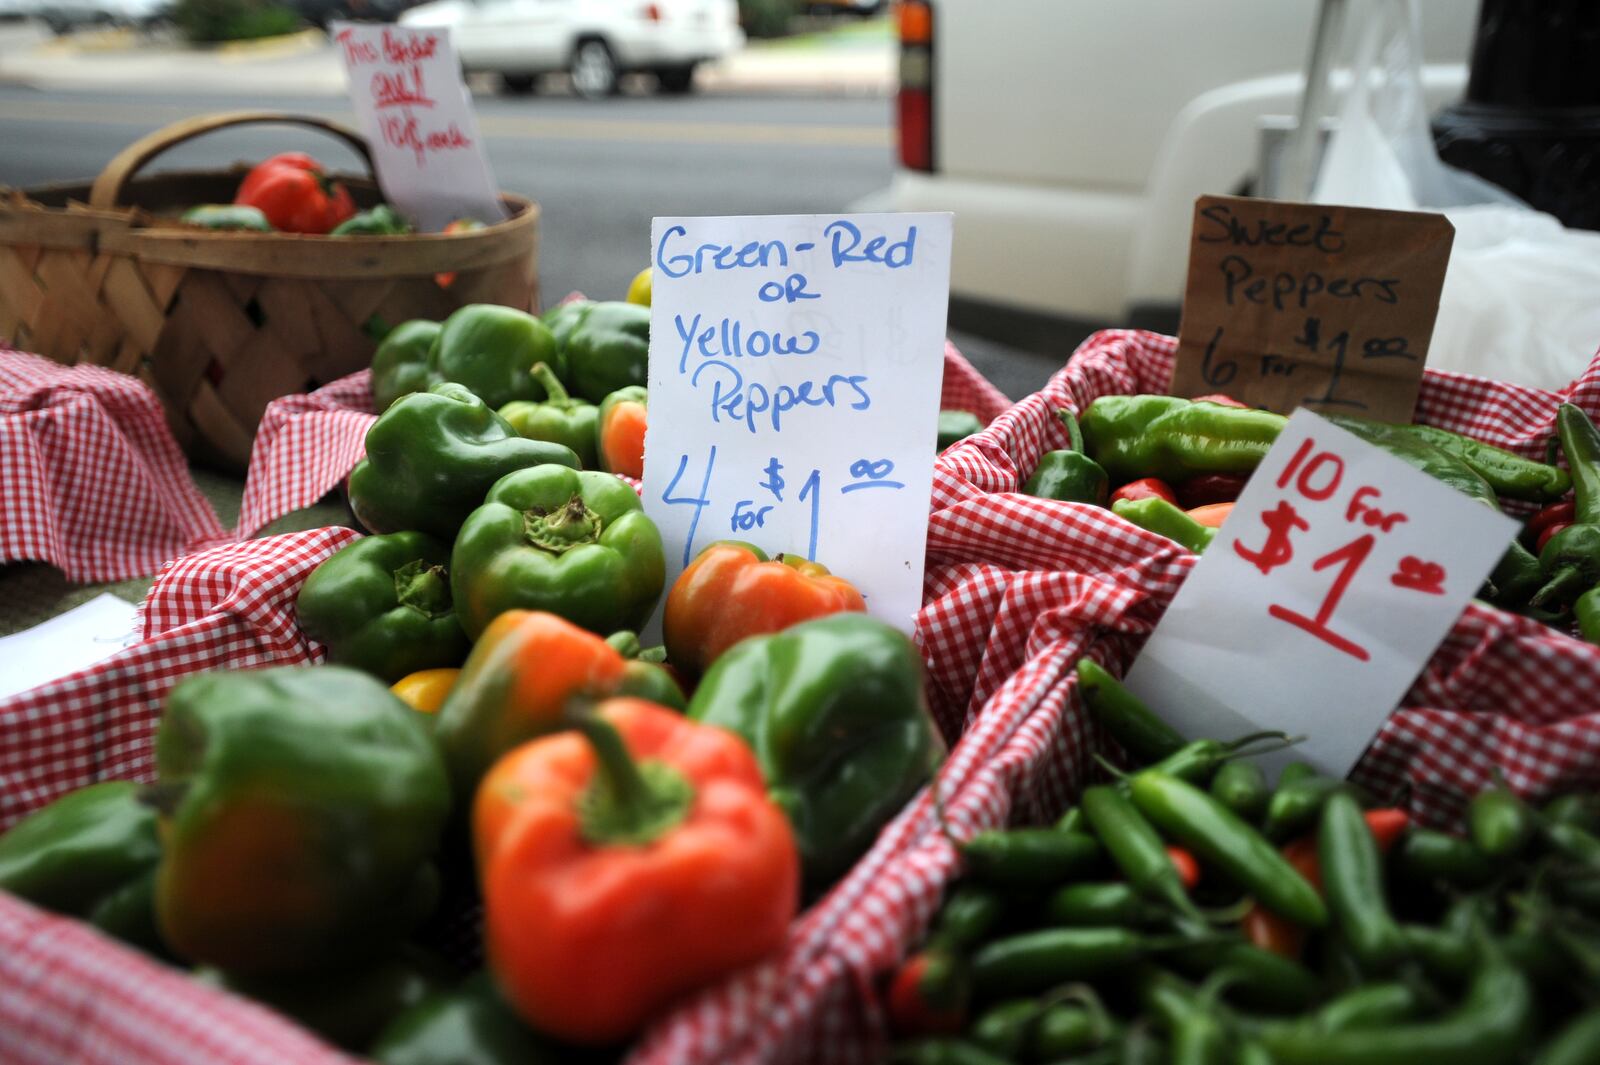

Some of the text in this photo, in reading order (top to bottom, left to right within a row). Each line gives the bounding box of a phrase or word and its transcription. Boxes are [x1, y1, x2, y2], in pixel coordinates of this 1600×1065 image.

[1199, 205, 1347, 253] Sweet
[757, 273, 821, 303] OR
[1219, 255, 1401, 311] Peppers
[674, 314, 820, 374] Yellow
[1202, 327, 1237, 387] 6
[691, 360, 871, 433] Peppers
[1276, 437, 1344, 501] 10
[662, 445, 716, 569] 4
